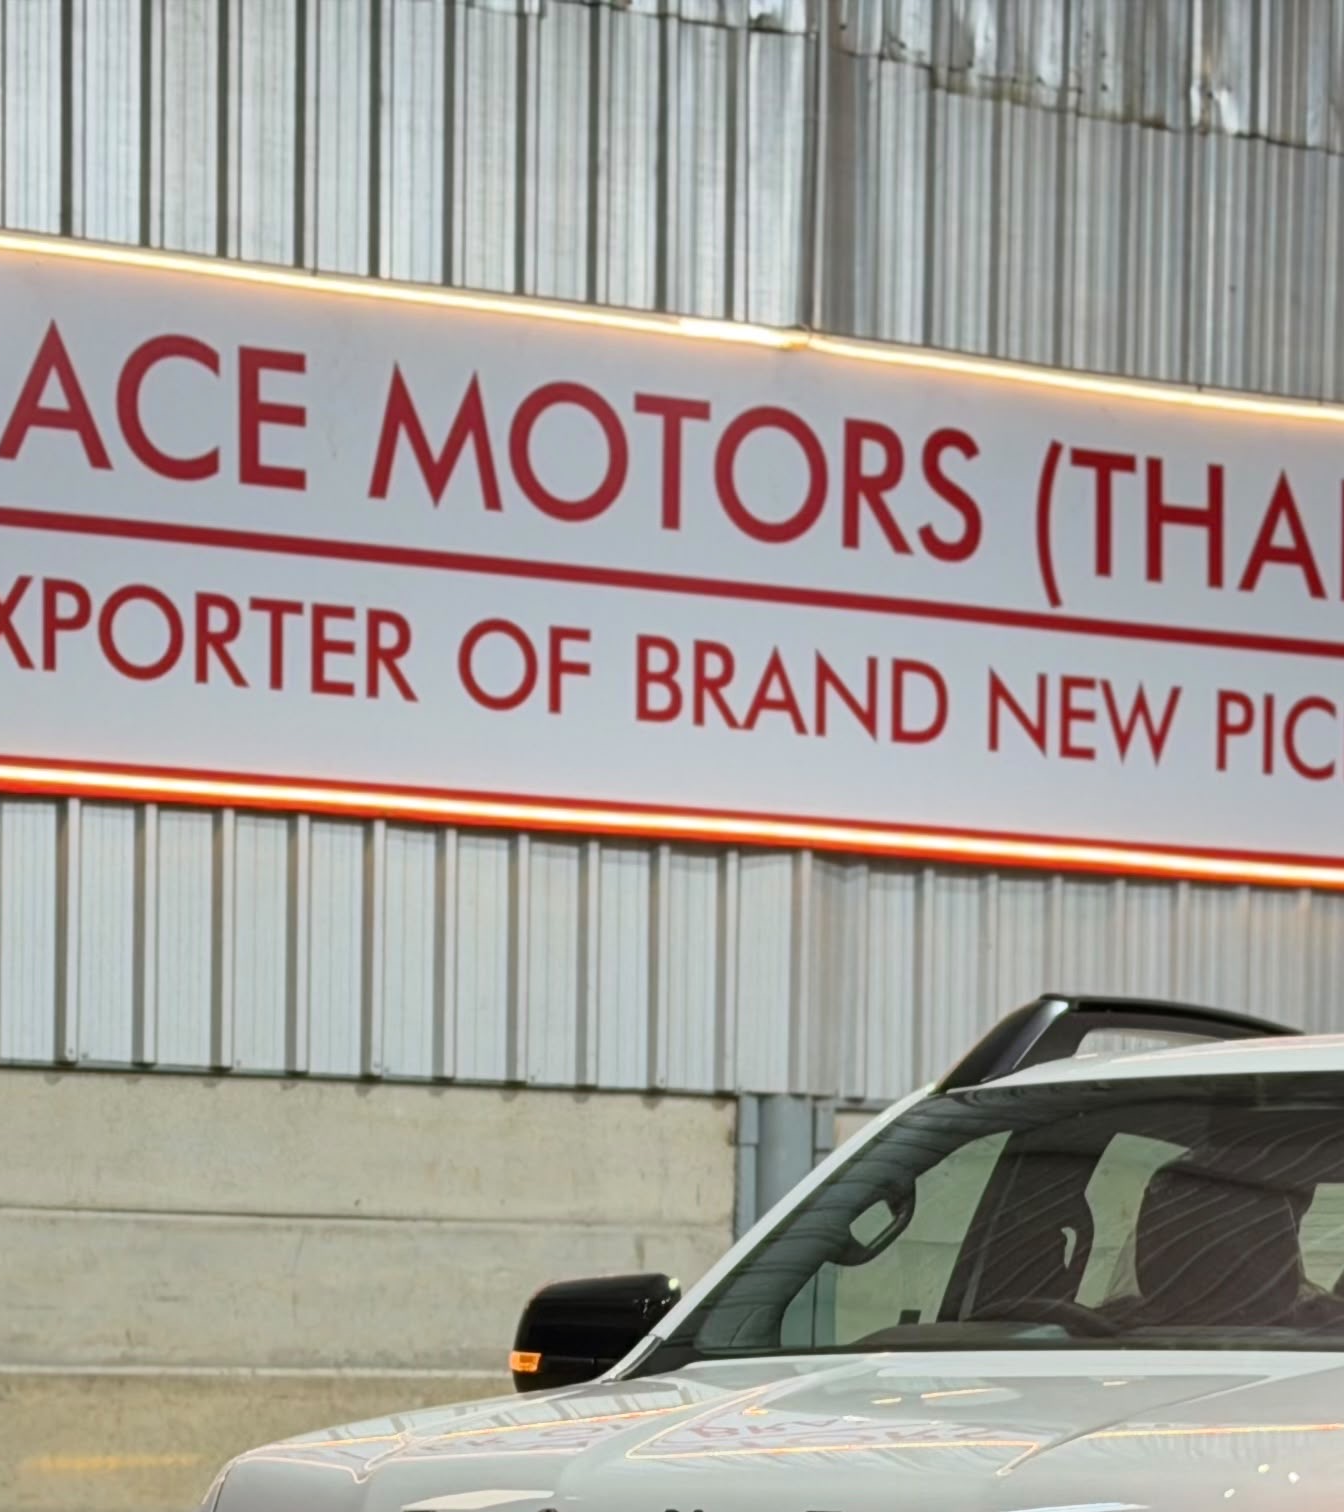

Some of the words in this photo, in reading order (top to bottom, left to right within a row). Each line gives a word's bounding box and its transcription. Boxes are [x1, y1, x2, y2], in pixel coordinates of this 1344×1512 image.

[367, 363, 984, 564] MOTORS
[457, 617, 592, 715] OF
[635, 633, 949, 745] BRAND
[987, 669, 1182, 763] NEW
